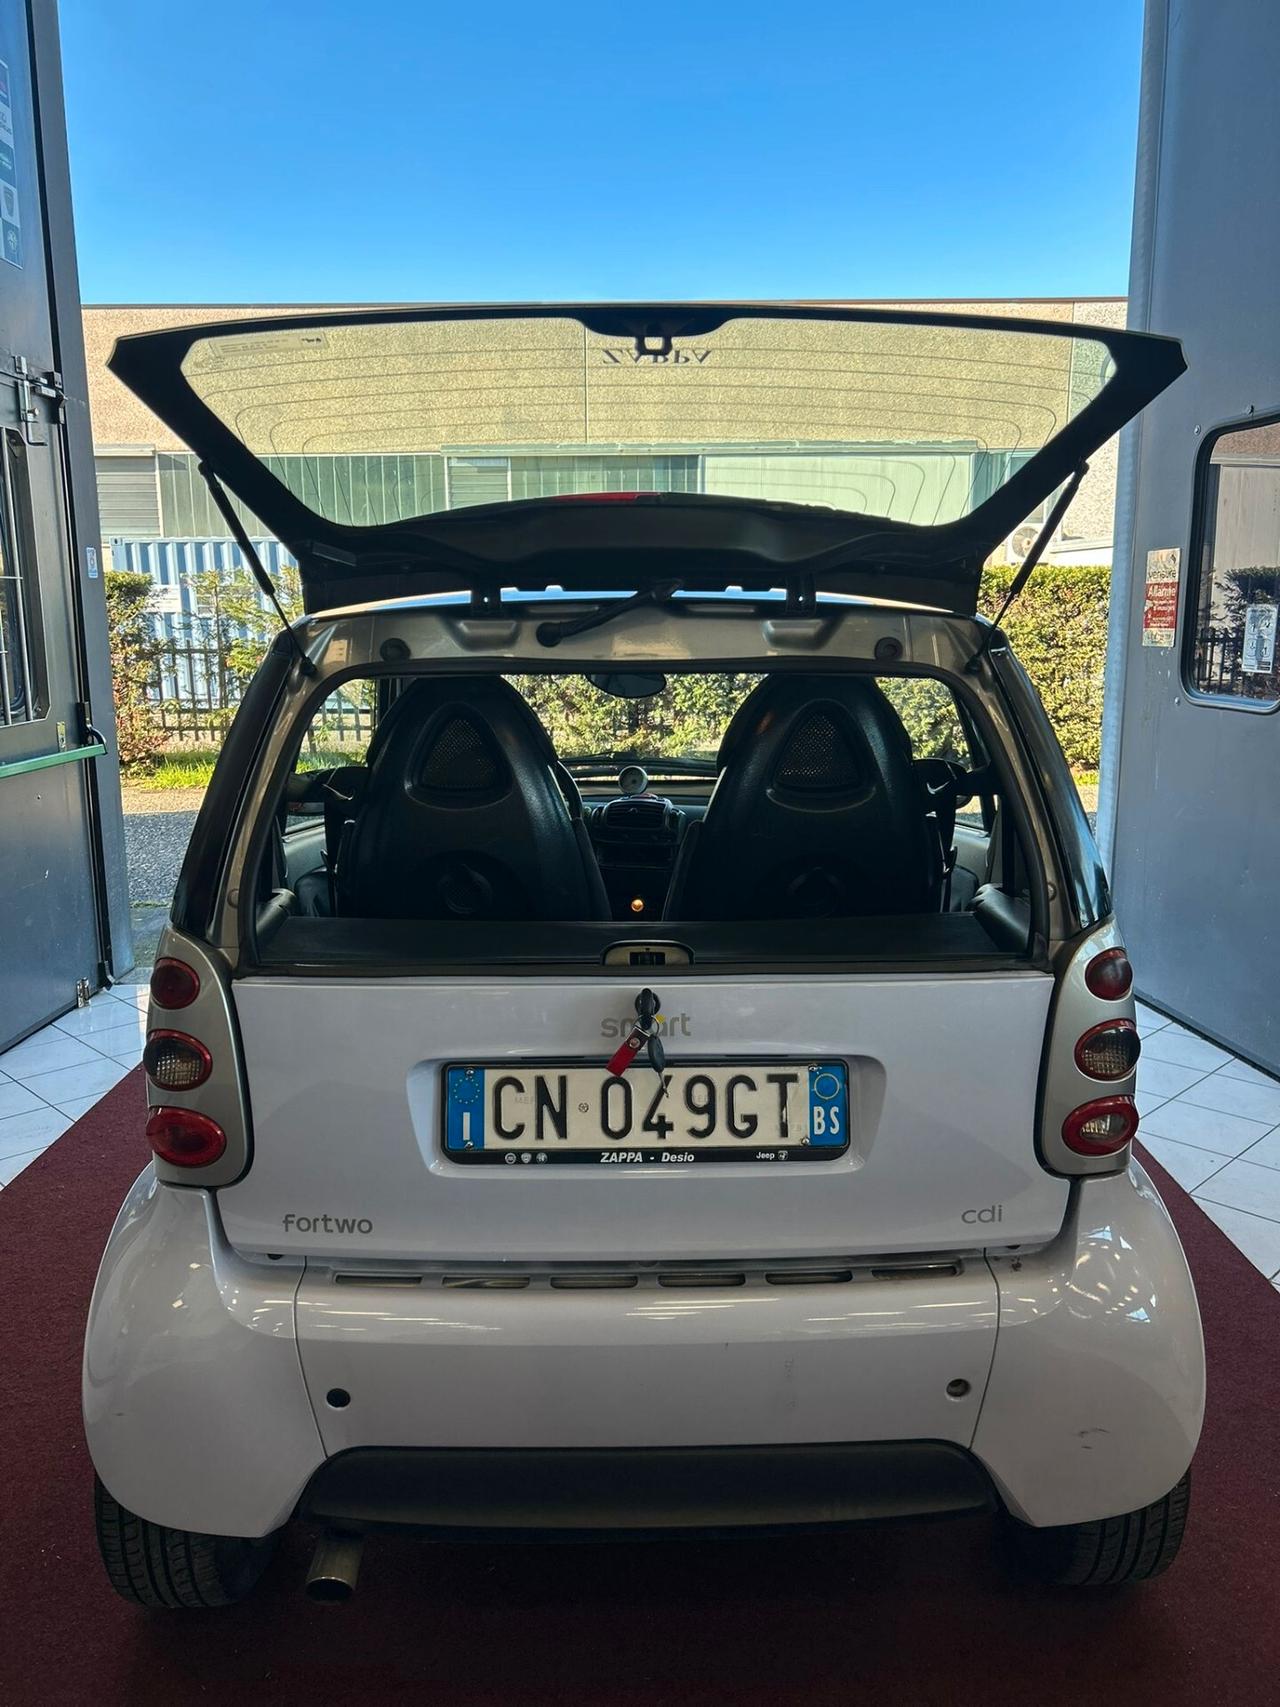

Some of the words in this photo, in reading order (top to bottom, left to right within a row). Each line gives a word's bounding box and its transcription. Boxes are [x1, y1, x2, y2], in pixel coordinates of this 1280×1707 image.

[493, 1075, 568, 1141] CN
[600, 1074, 799, 1140] 049GT
[812, 1105, 840, 1136] BS
[600, 1152, 643, 1163] ZAPPA
[661, 1151, 696, 1162] Desio
[756, 1152, 775, 1161] Jeep
[282, 1214, 374, 1234] fortwo
[961, 1205, 1003, 1224] cdi
